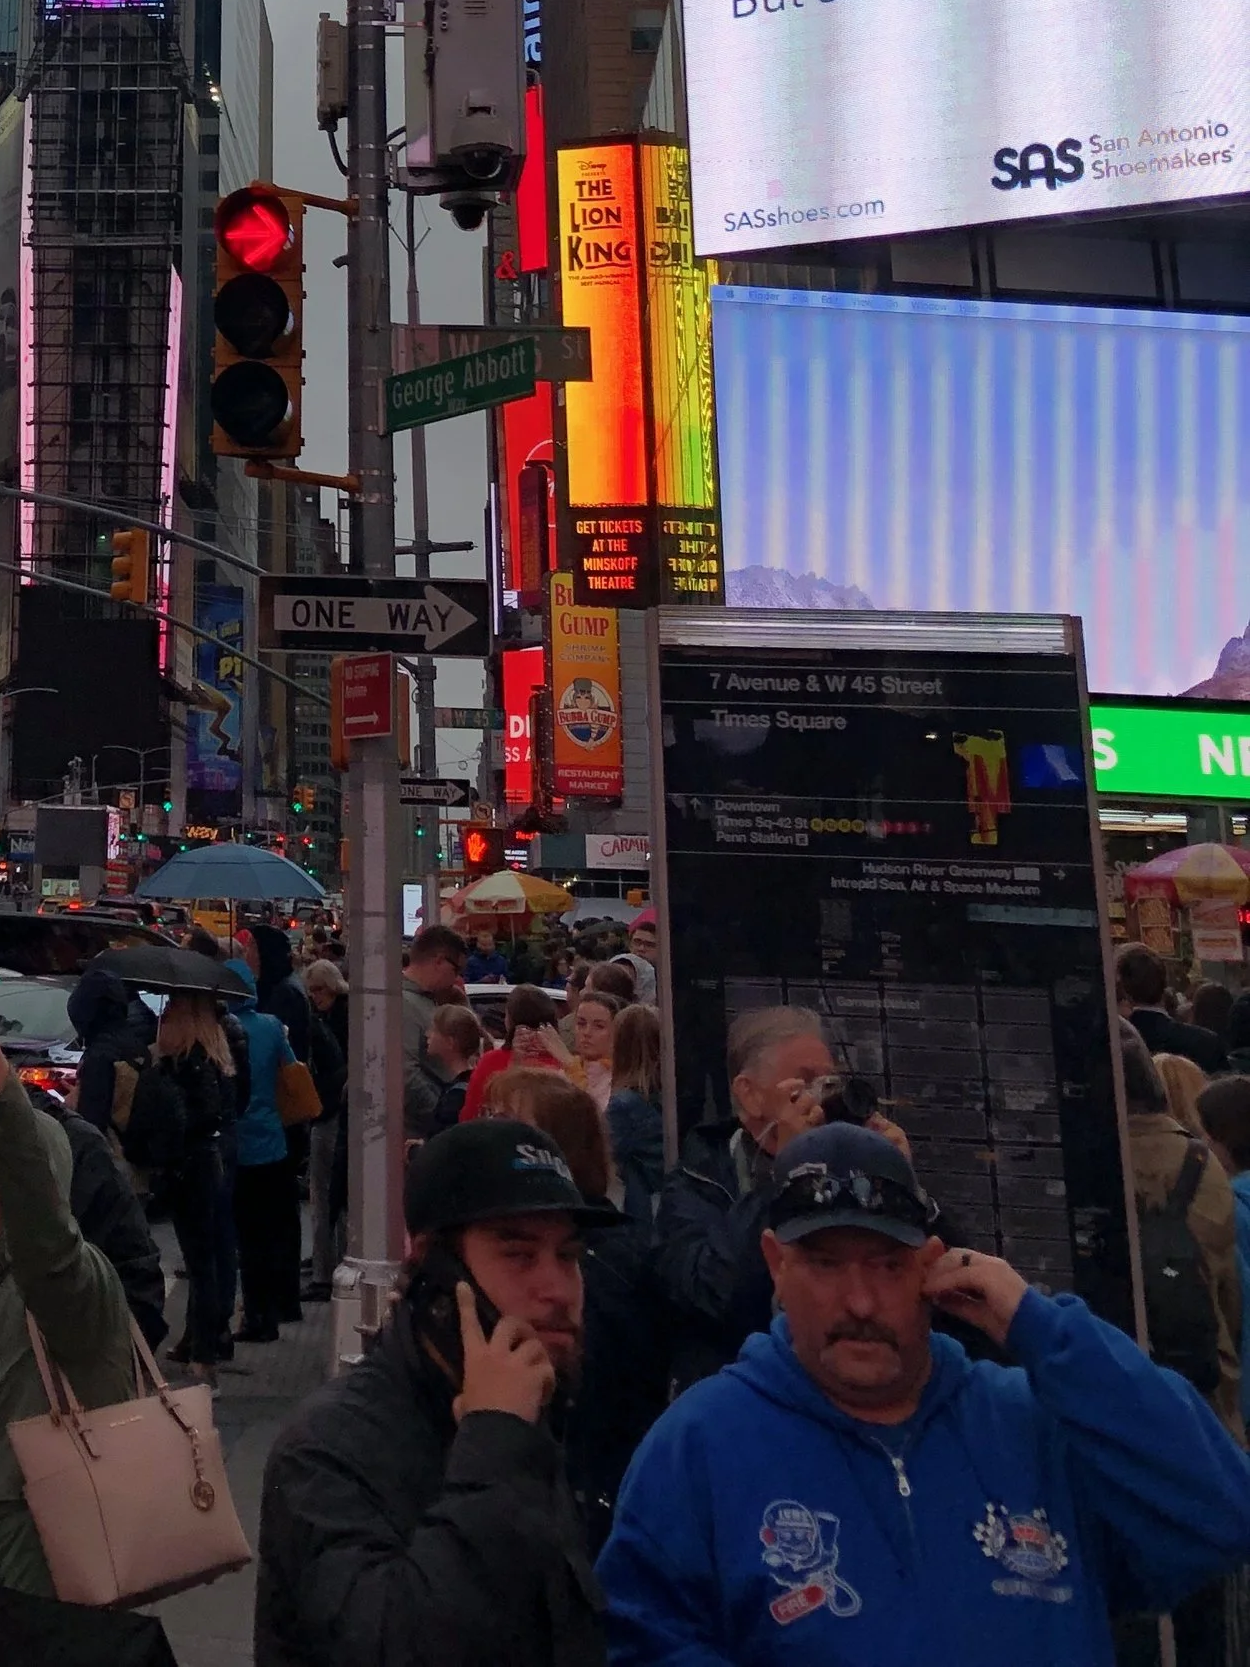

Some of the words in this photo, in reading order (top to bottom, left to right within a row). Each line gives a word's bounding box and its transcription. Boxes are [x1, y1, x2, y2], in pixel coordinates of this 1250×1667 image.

[1088, 133, 1133, 156] San
[1137, 120, 1230, 148] Antonio
[990, 138, 1085, 193] SAS
[574, 178, 613, 198] THE
[723, 196, 886, 234] SASshoes.com
[567, 235, 632, 271] KING
[560, 335, 585, 361] St
[391, 368, 455, 410] George
[462, 344, 527, 391] Abbott
[576, 520, 597, 534] GET
[598, 520, 643, 534] TICKETS
[592, 539, 606, 552] AT
[607, 539, 628, 552] THE
[583, 557, 638, 571] MINSKOFF
[587, 575, 635, 590] THEATRE
[291, 599, 356, 629] ONE
[387, 603, 454, 632] WAY
[560, 613, 610, 637] GUMP
[709, 672, 721, 691] 7
[725, 673, 802, 693] Avenue
[805, 674, 821, 693] &
[823, 674, 847, 693] W
[850, 675, 877, 694] 45
[880, 675, 944, 695] Street
[558, 712, 589, 725] BUBBA
[709, 708, 772, 728] Times
[774, 709, 848, 733] Square
[557, 768, 620, 779] RESTAURANT
[433, 786, 456, 797] WAY
[568, 781, 611, 791] MARKET
[714, 799, 780, 813] Downtown
[715, 814, 752, 828] Times
[715, 831, 748, 844] Penn
[750, 834, 793, 846] Station
[861, 860, 911, 876] Hudson
[912, 862, 946, 878] River
[948, 865, 1012, 881] Greenway
[830, 876, 878, 892] Intrepid
[909, 879, 928, 892] Air
[942, 881, 984, 895] Space
[985, 882, 1042, 896] Museum
